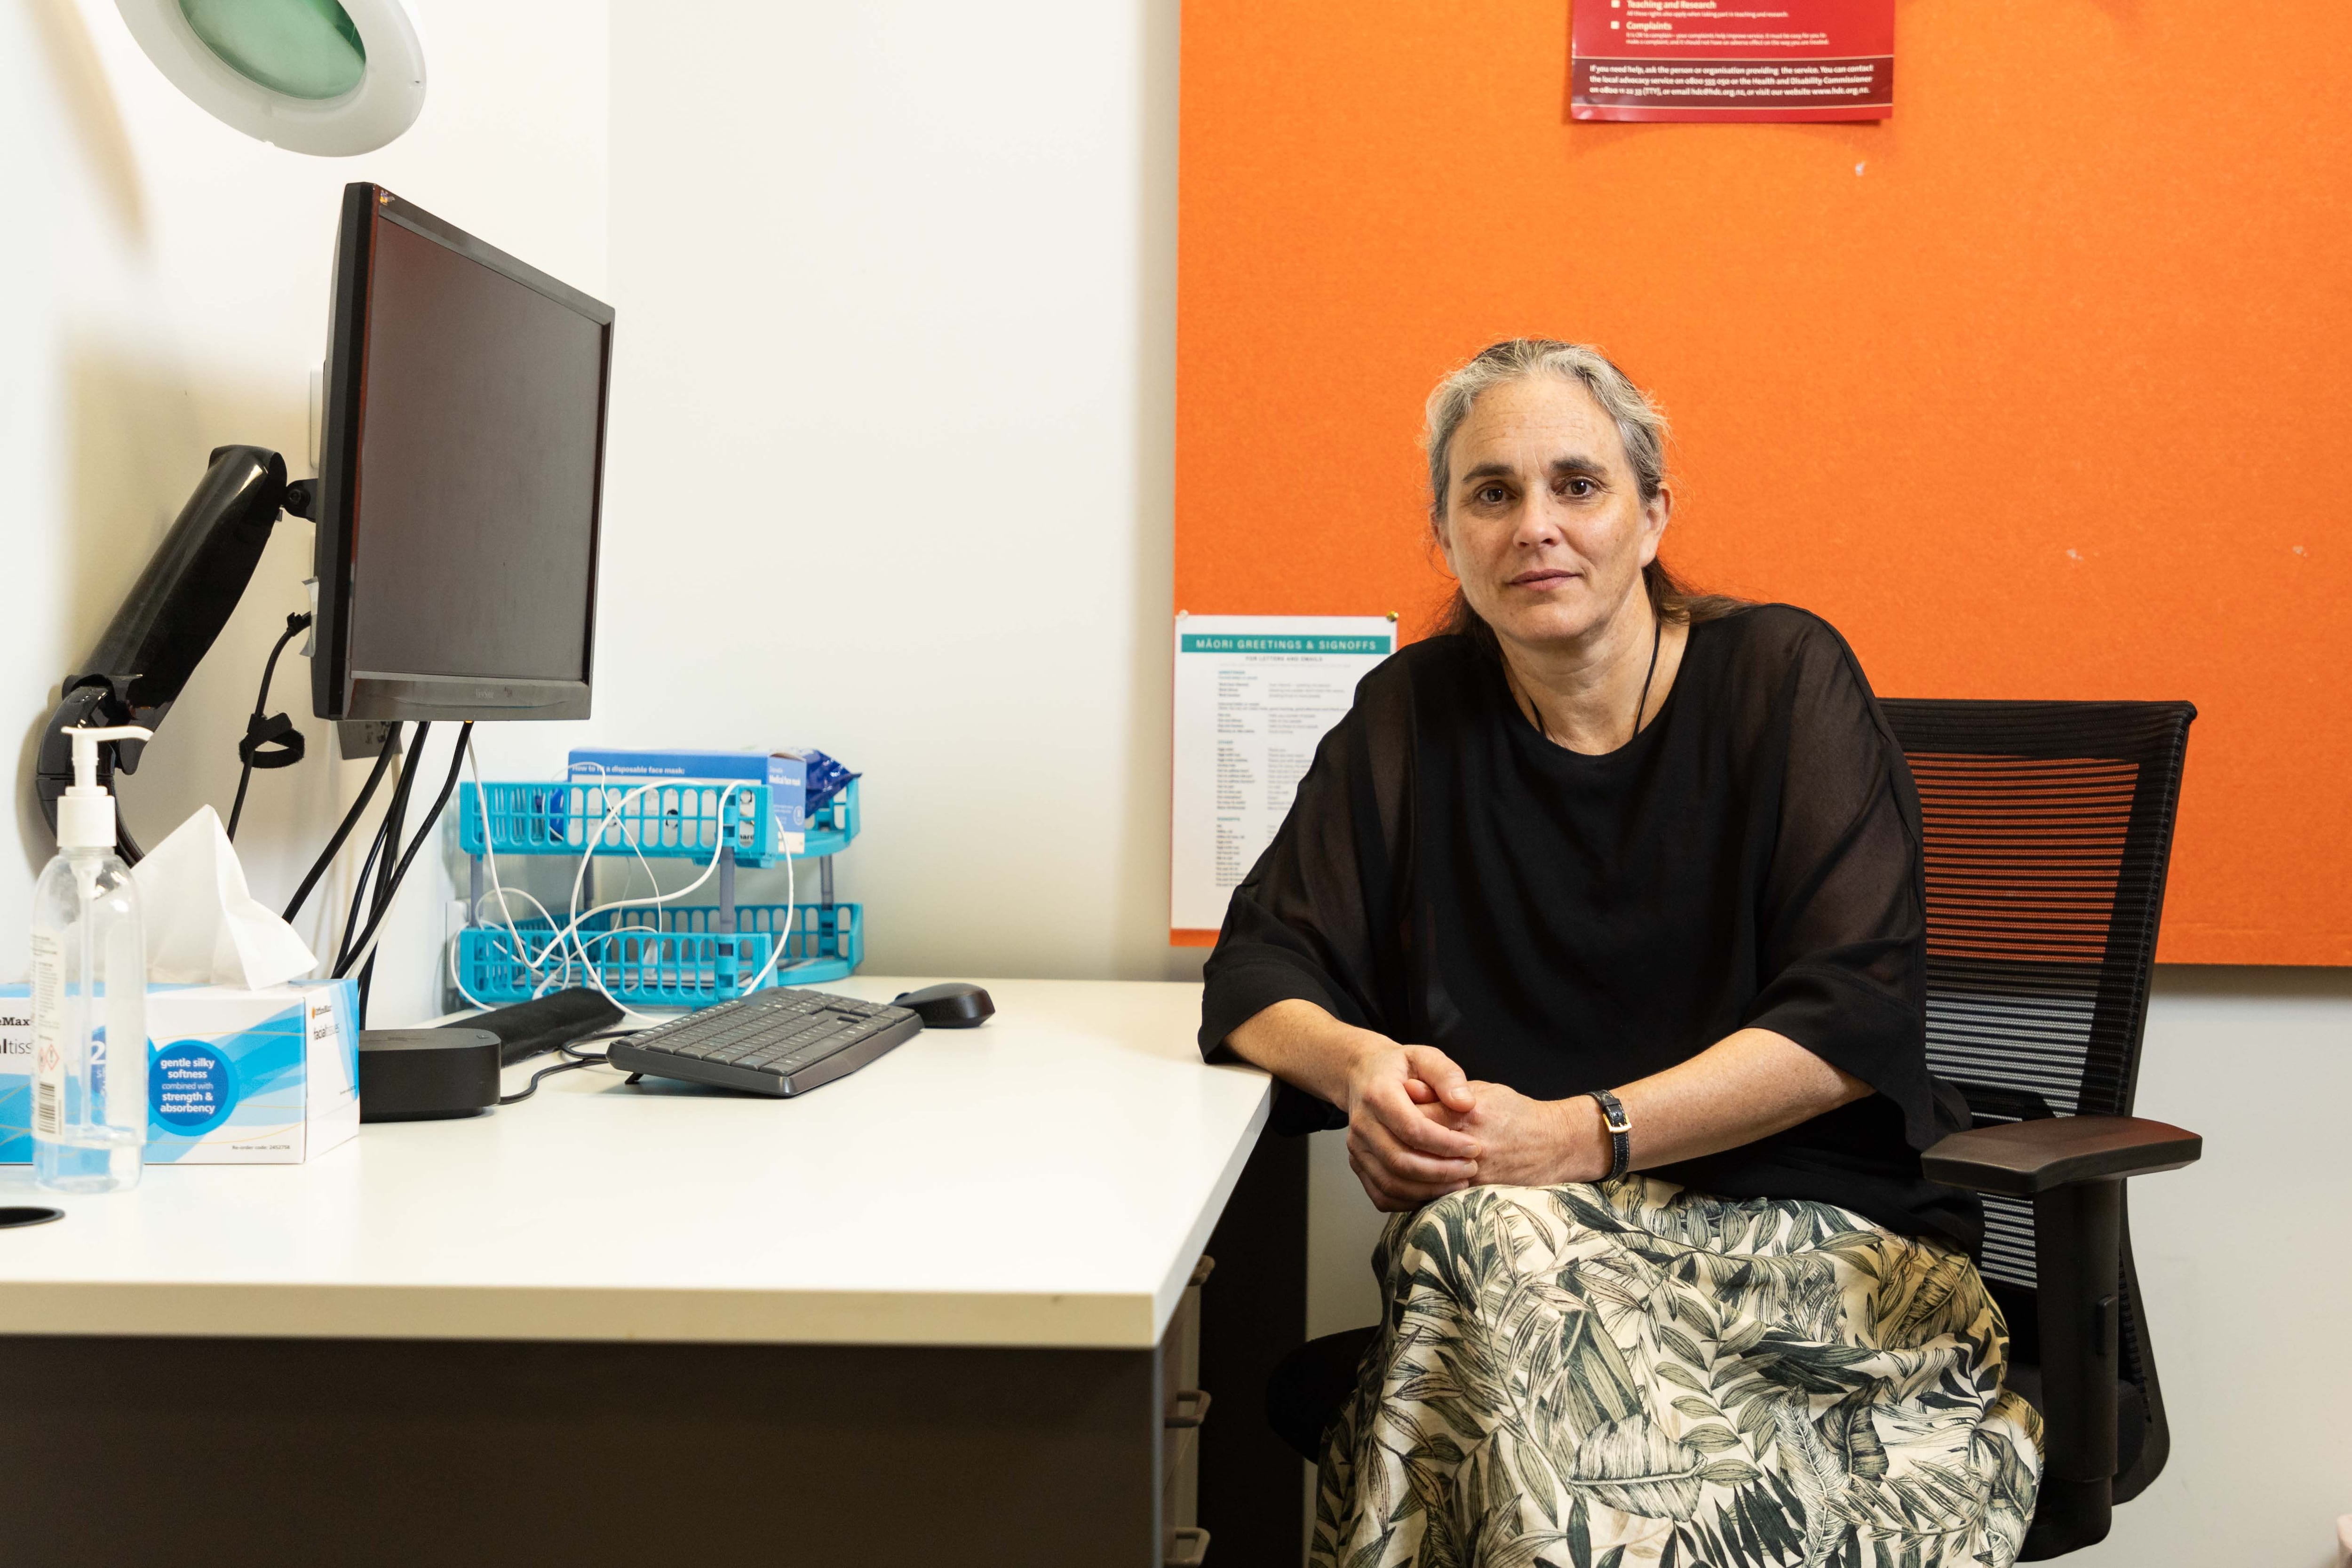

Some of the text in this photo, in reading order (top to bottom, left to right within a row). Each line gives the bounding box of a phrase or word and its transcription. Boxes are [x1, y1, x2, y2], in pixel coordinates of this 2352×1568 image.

[1628, 0, 1663, 10] Teaching
[1626, 21, 1672, 32] Complaints
[1628, 65, 1644, 74] help,
[1702, 66, 1745, 76] organisation
[1746, 65, 1779, 76] providing
[1781, 65, 1792, 74] the
[1847, 64, 1874, 72] contact
[1619, 76, 1649, 86] advocacy
[1790, 77, 1823, 86] Disability
[1823, 75, 1873, 84] Commissioner
[1643, 87, 1662, 96] (TTY),
[1691, 87, 1747, 97] hdc@hdc.org.nz,
[1812, 87, 1870, 96] www.hdc.org.nz.
[1196, 637, 1376, 650] MĀORI GREETINGS & SIGNOFFS
[612, 765, 647, 774] disposable
[0, 1017, 30, 1026] Max
[160, 1058, 215, 1069] gentle silky
[167, 1069, 207, 1078] softness
[162, 1092, 213, 1102] strength &
[160, 1103, 215, 1114] absorbency
